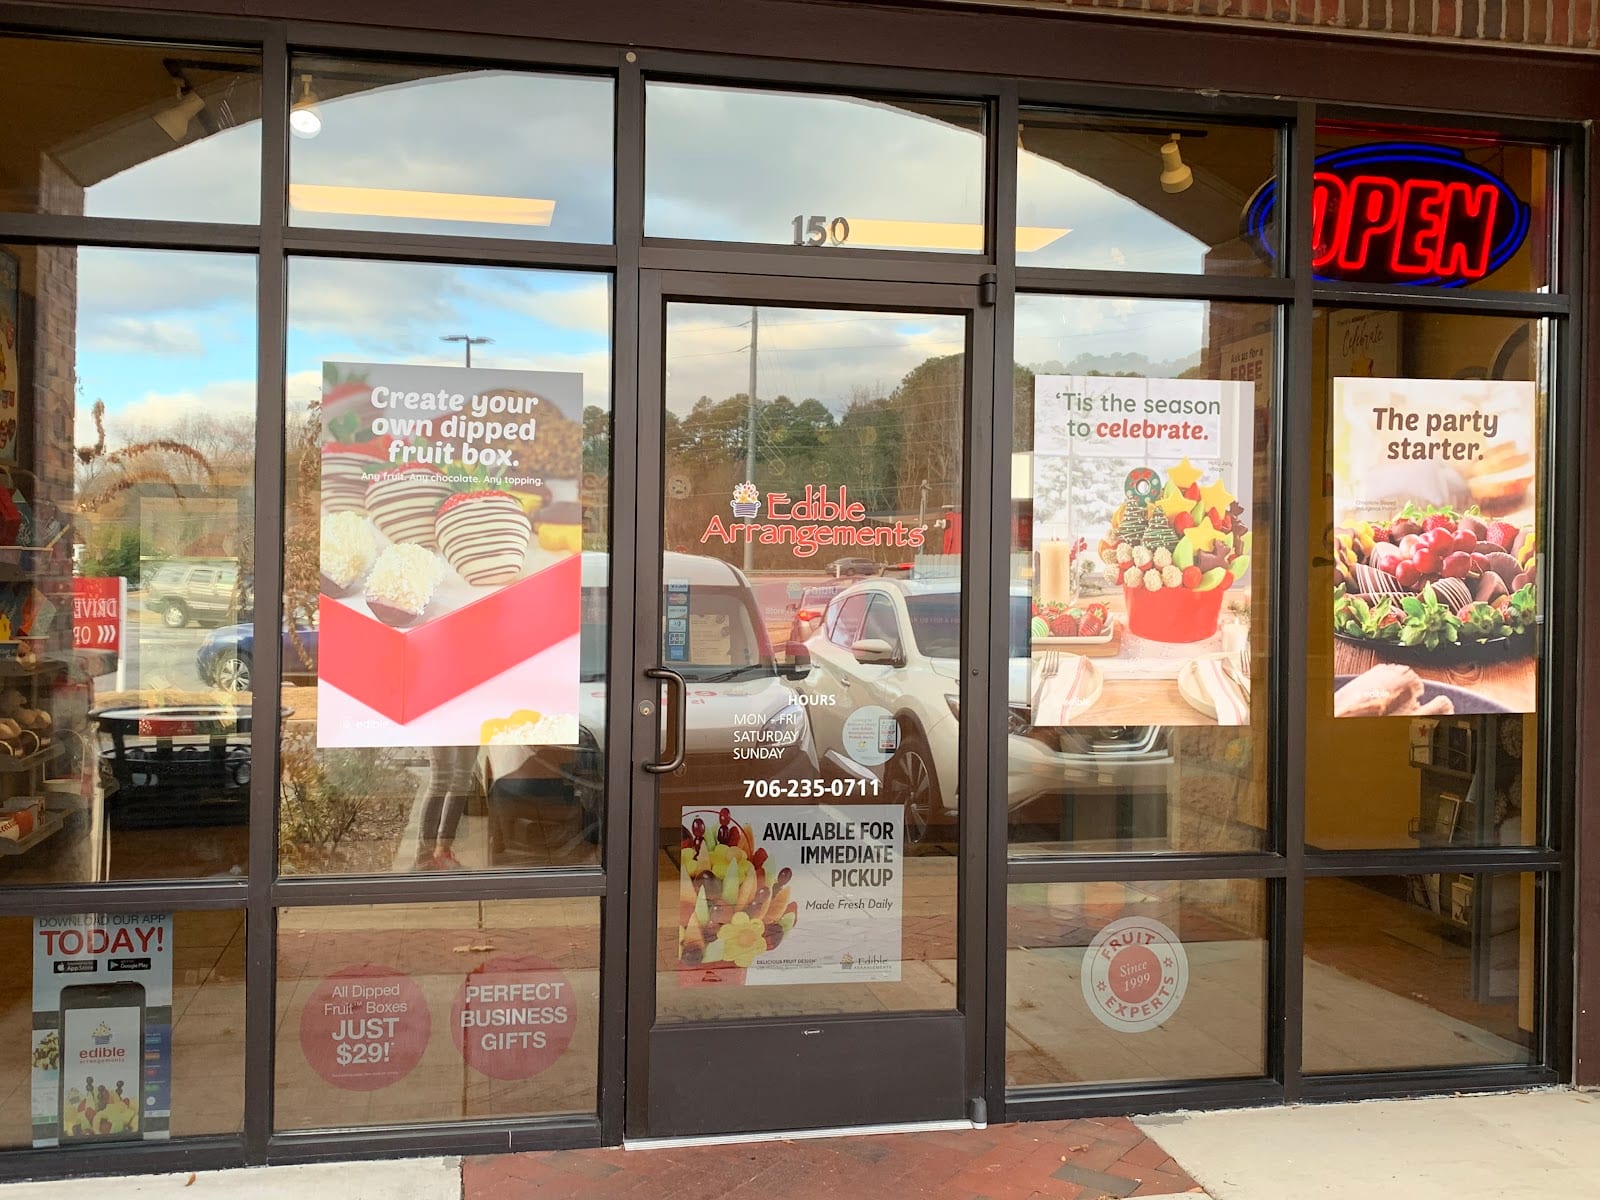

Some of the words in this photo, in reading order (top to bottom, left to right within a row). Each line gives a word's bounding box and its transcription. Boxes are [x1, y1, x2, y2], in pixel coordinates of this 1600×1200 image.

[792, 215, 850, 246] 150
[1312, 172, 1498, 277] OPEN
[371, 386, 464, 412] Create
[471, 391, 539, 417] your
[1101, 394, 1136, 412] the
[1144, 398, 1221, 415] season
[371, 418, 433, 437] own
[440, 415, 536, 442] dipped
[1067, 420, 1091, 437] to
[1096, 419, 1209, 440] celebrate.
[1373, 407, 1419, 431] The
[1426, 410, 1498, 438] party
[388, 440, 453, 465] fruit
[462, 443, 519, 467] box.
[1387, 437, 1484, 461] starter.
[361, 472, 380, 481] Any
[382, 472, 406, 481] fruit.
[409, 474, 428, 483] Any
[430, 473, 481, 483] chocolate.
[484, 475, 502, 485] Any
[504, 476, 544, 486] topping.
[767, 484, 866, 522] Edible
[788, 694, 836, 706] HOURS
[734, 714, 766, 725] MON
[779, 713, 798, 725] FRI
[734, 731, 799, 742] SATURDAY
[733, 748, 785, 760] SUNDAY
[743, 779, 879, 798] 706-235-0711
[763, 822, 855, 841] AVAILABLE
[860, 821, 894, 841] FOR
[800, 845, 893, 864] IMMEDIATE
[831, 869, 893, 887] PICKUP
[805, 900, 835, 910] Made
[837, 899, 865, 910] Fresh
[868, 898, 893, 911] Daily
[40, 914, 108, 928] DOWNLOAD
[113, 914, 139, 925] OUR
[142, 913, 166, 924] APP
[39, 927, 163, 956] TODAY!
[1101, 931, 1155, 960] FRUIT
[67, 963, 78, 972] App
[857, 955, 888, 965] Edible
[1120, 961, 1148, 977] Since
[332, 985, 348, 998] All
[352, 984, 400, 999] Dipped
[1124, 972, 1151, 992] 1999
[466, 982, 564, 1003] PERFECT
[1105, 976, 1174, 1018] EXPERTS
[366, 1001, 408, 1013] Boxes
[460, 1007, 568, 1028] BUSINESS
[332, 1017, 399, 1041] JUST
[481, 1031, 547, 1051] GIFTS
[79, 1047, 126, 1059] edible
